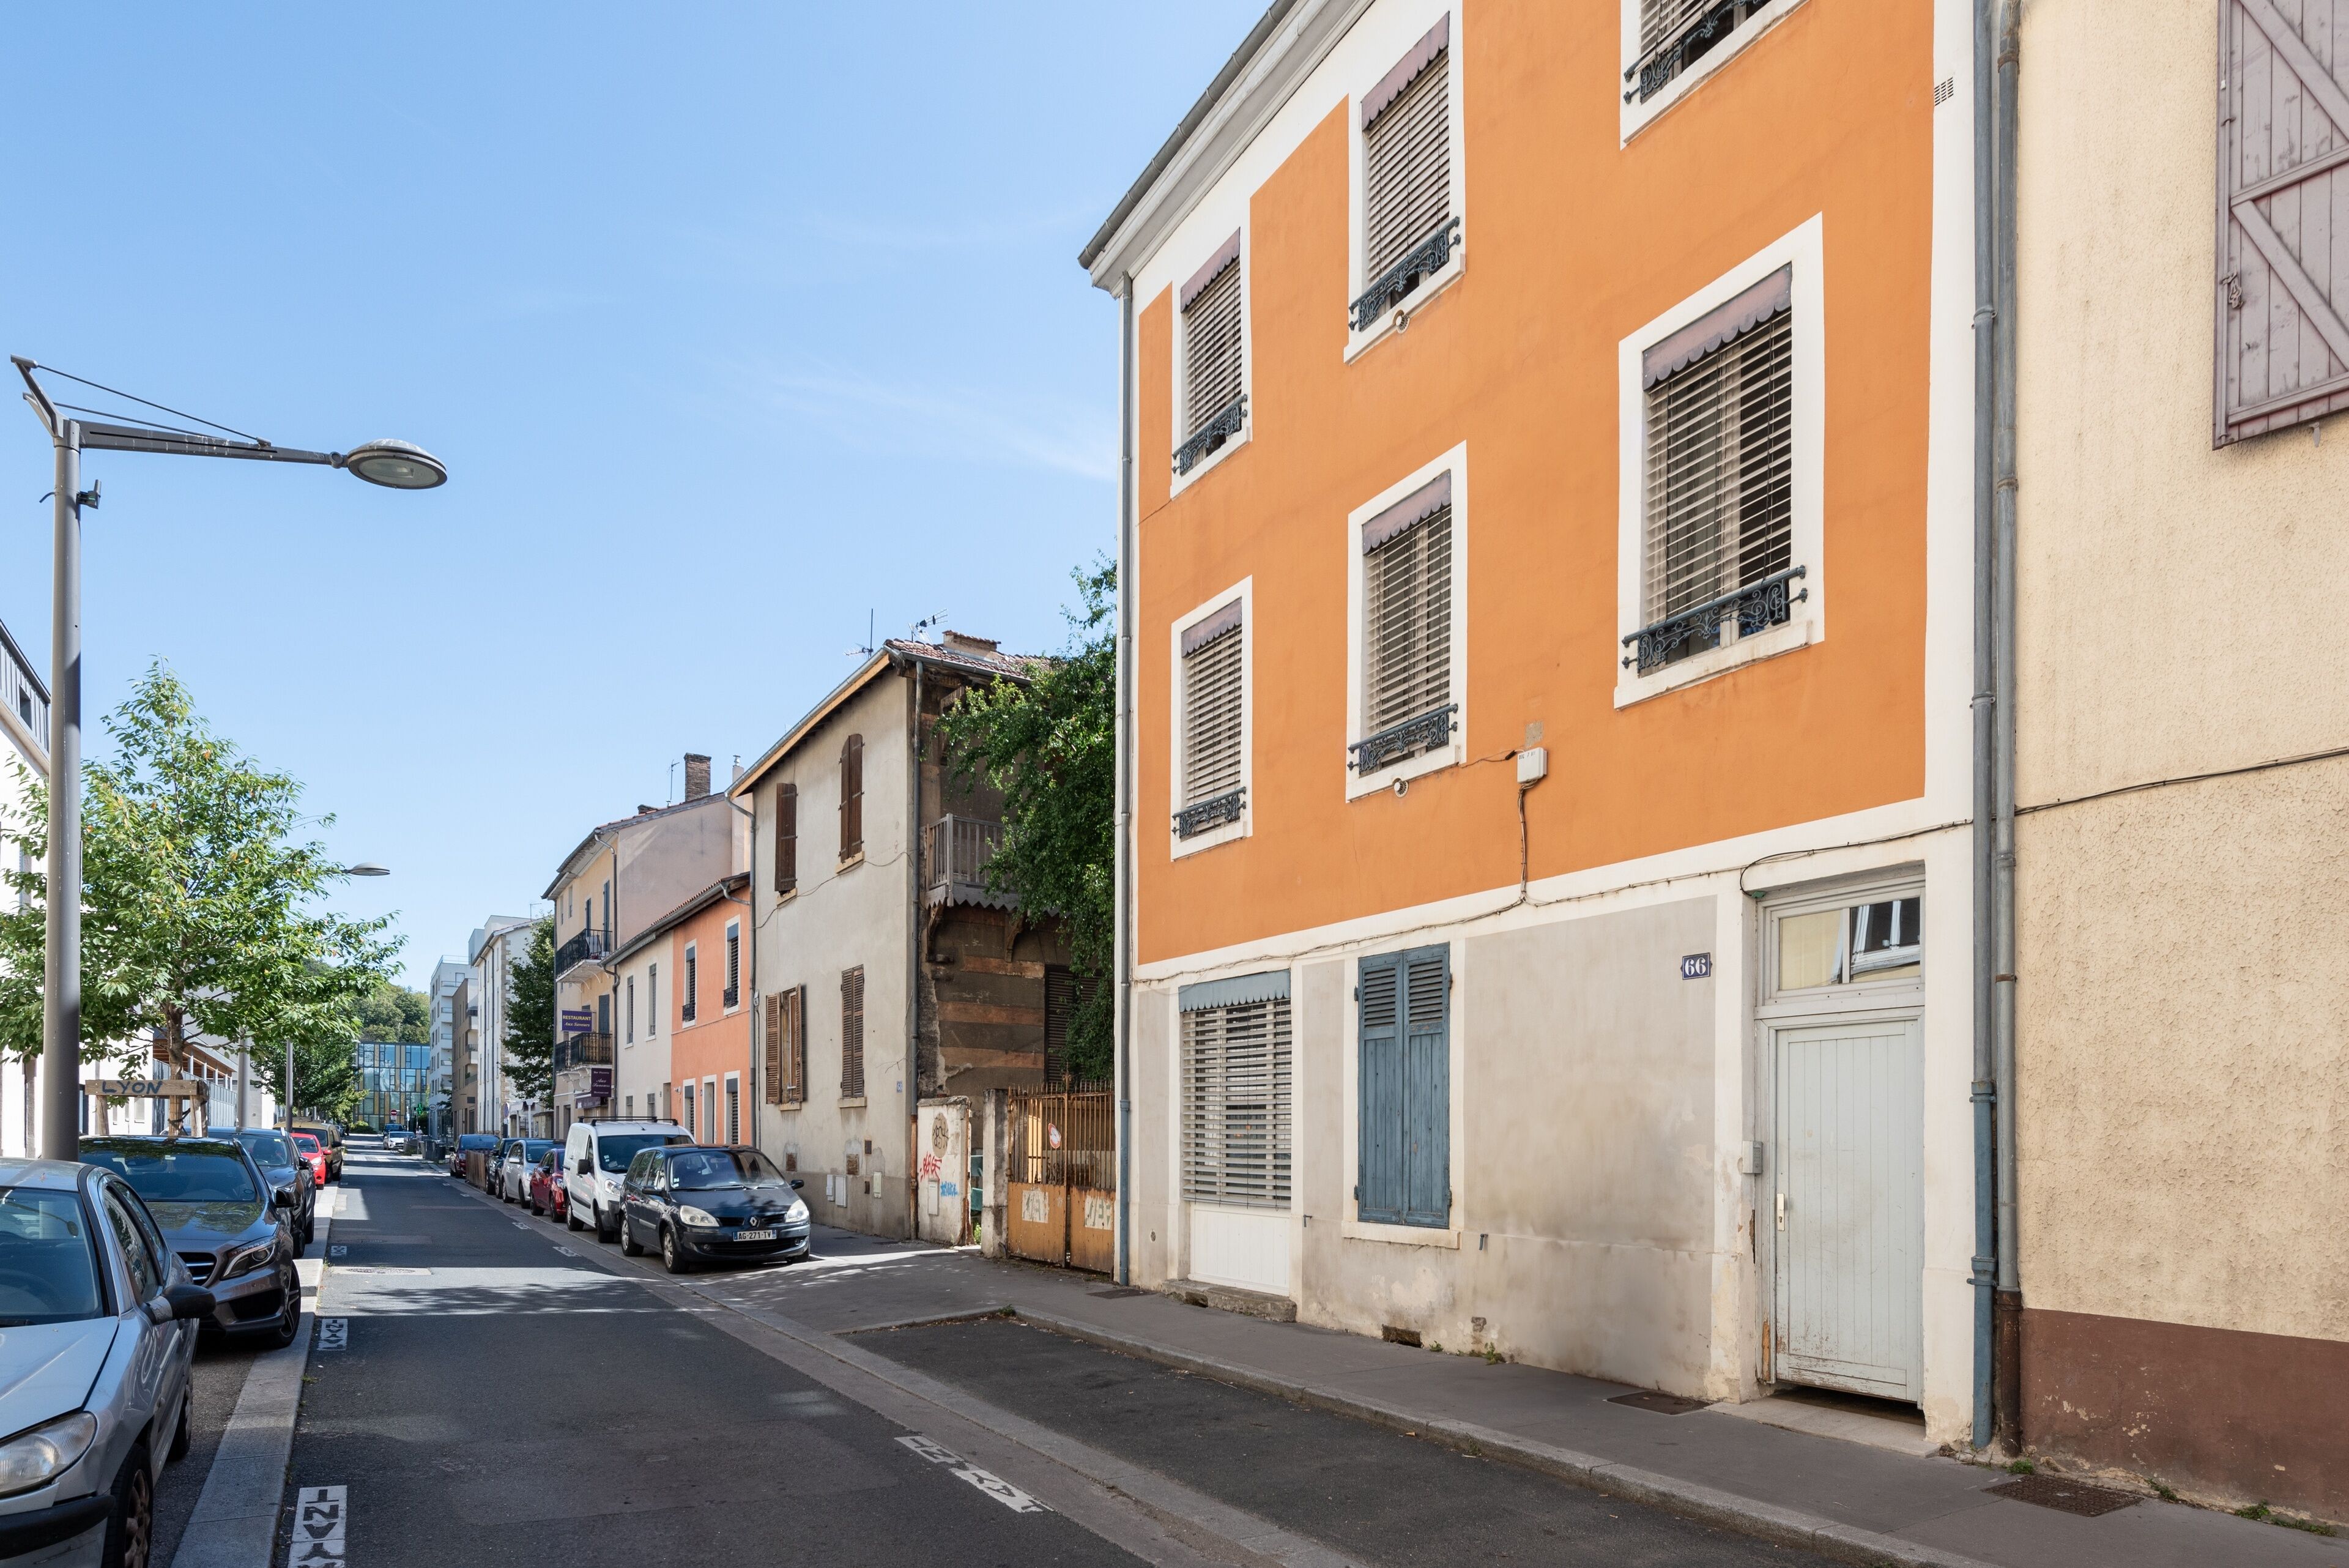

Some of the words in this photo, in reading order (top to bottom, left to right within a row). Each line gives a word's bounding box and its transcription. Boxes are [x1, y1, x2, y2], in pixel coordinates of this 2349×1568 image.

[1685, 957, 1707, 976] 66
[102, 1080, 163, 1094] LYON
[738, 1231, 771, 1240] AG-271-TV
